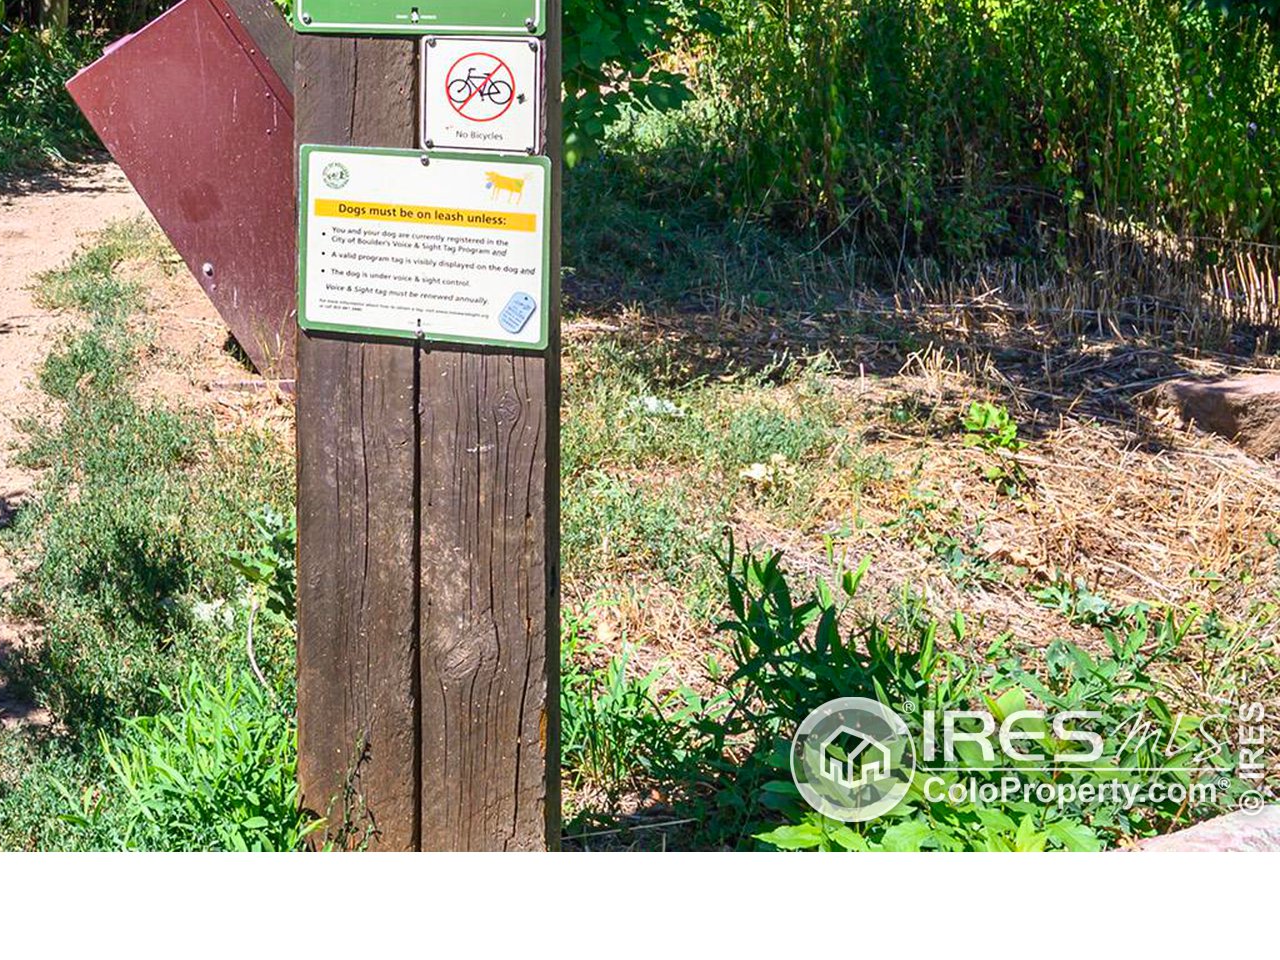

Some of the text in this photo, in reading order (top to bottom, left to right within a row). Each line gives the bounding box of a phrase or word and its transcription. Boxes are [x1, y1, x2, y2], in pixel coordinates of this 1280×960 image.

[455, 130, 503, 141] No Bicycles
[338, 203, 507, 226] Dogs must be on leash unless:
[332, 226, 346, 234] You
[347, 227, 362, 235] and
[363, 229, 380, 237] your
[381, 230, 397, 239] dog
[411, 233, 444, 242] currently
[446, 236, 485, 245] registered
[331, 235, 346, 244] City
[357, 237, 391, 246] Boulder's
[422, 243, 441, 252] Sight
[443, 245, 457, 254] Tag
[457, 246, 491, 255] Program
[491, 249, 508, 257] and
[357, 254, 390, 263] program
[391, 256, 404, 265] tag
[413, 258, 437, 267] visibly
[438, 260, 475, 270] displayed
[502, 265, 519, 274] dog
[520, 267, 536, 275] and
[331, 268, 344, 276] The
[345, 270, 361, 279] dog
[369, 272, 392, 280] under
[422, 277, 441, 286] sight
[325, 283, 345, 291] Voice
[354, 286, 373, 294] Sight
[375, 288, 387, 296] tag
[388, 289, 408, 297] must
[409, 290, 419, 298] be
[419, 292, 454, 301] renewed
